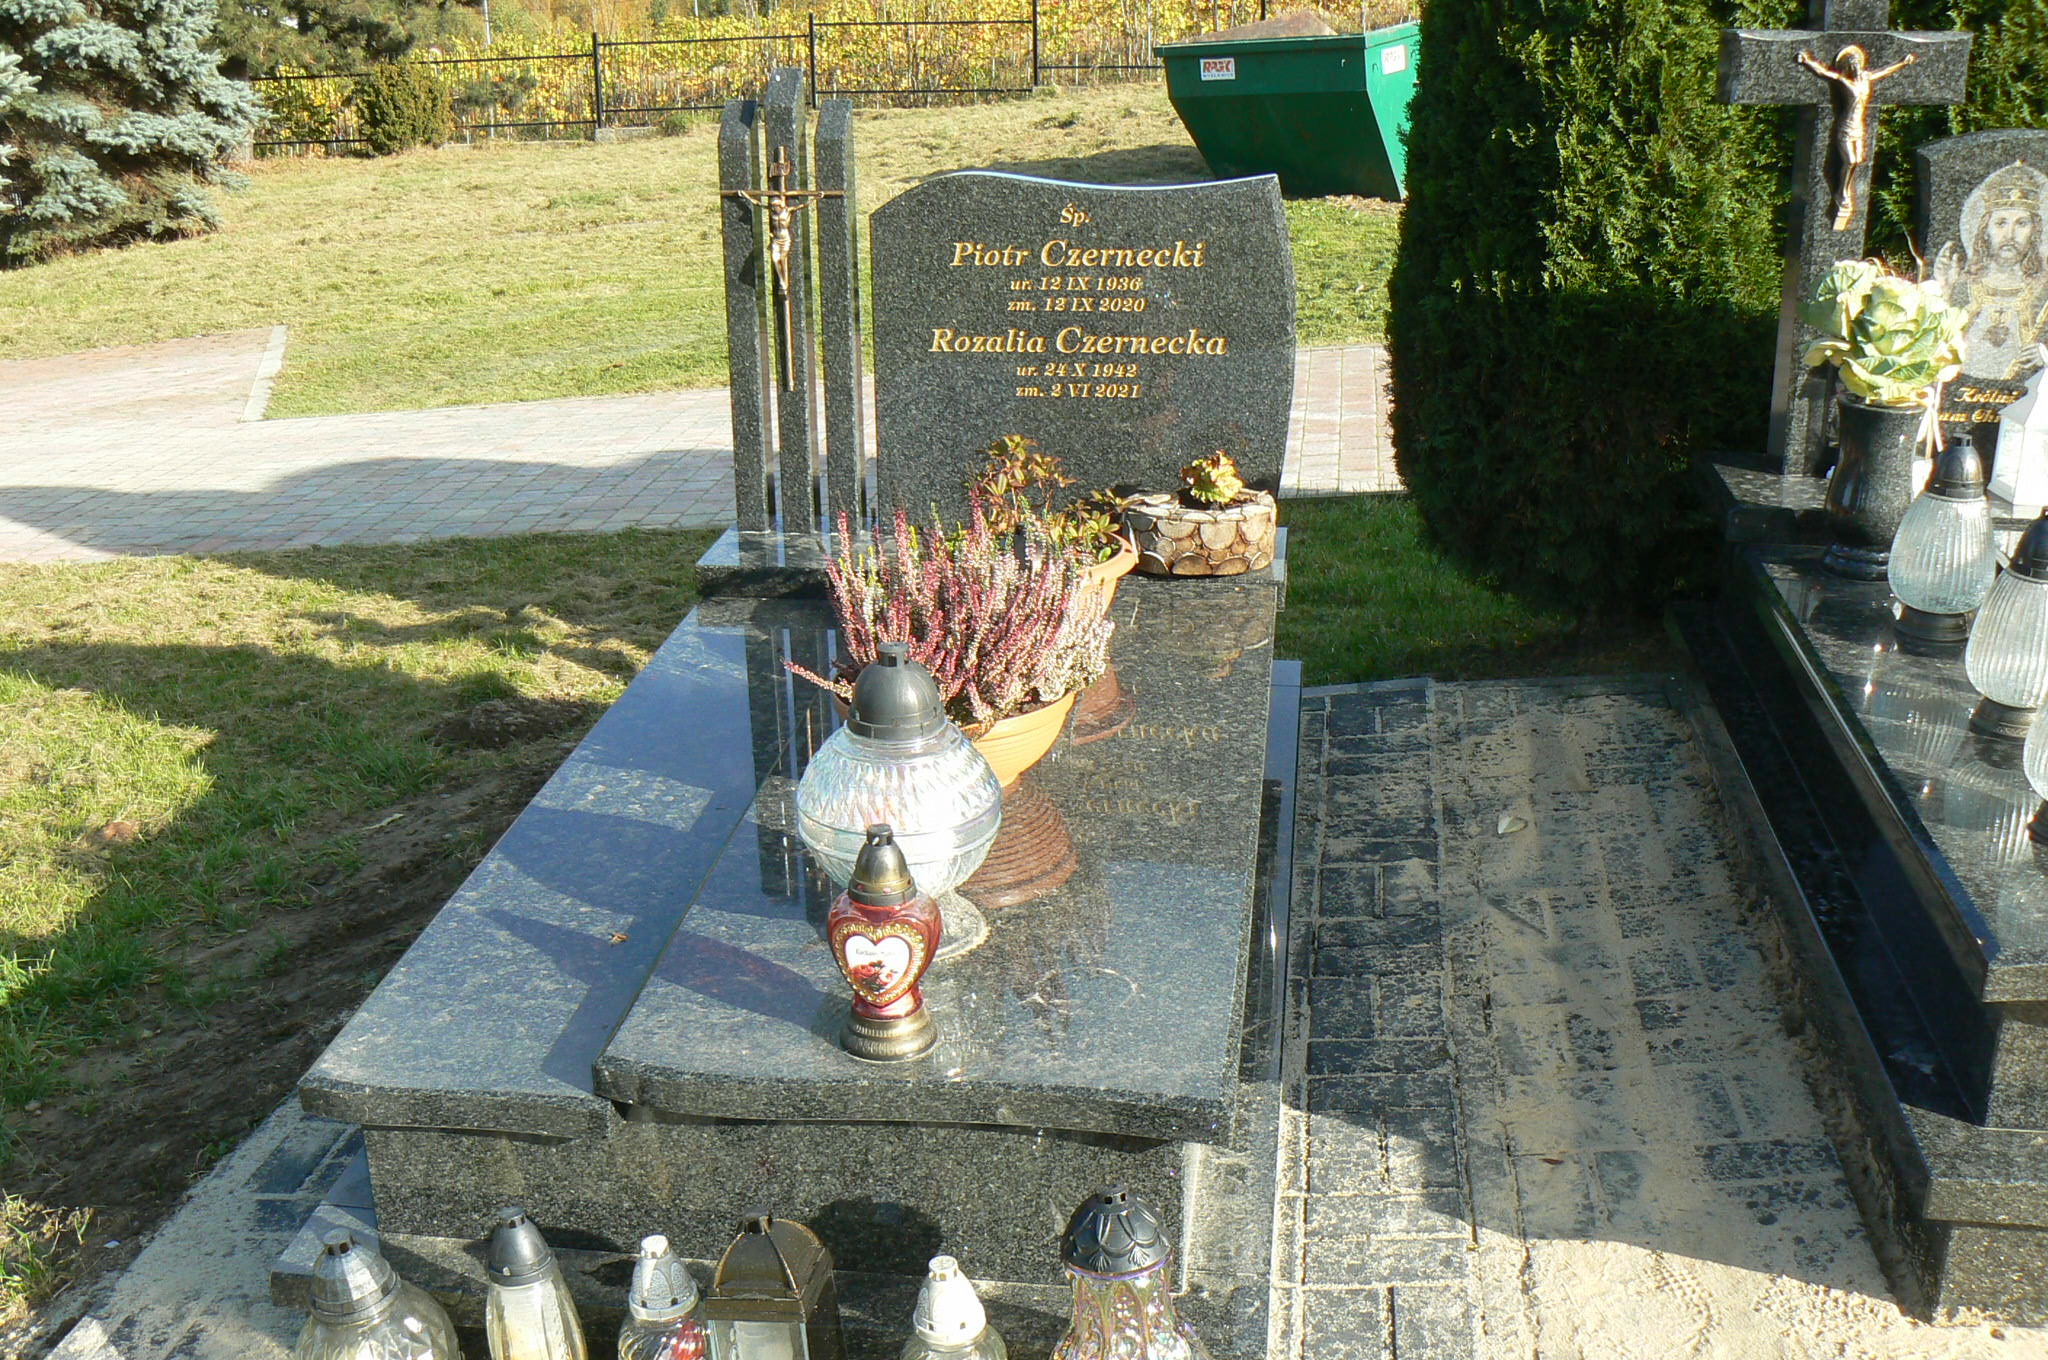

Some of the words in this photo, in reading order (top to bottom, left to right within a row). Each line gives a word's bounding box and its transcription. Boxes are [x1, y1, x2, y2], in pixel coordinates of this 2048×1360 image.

[1060, 203, 1091, 227] Śp.
[950, 241, 1032, 266] Piotr
[1040, 239, 1206, 267] Czernecki
[1010, 279, 1033, 291] ur.
[1039, 276, 1063, 291] 12
[1066, 276, 1091, 291] IX
[1097, 276, 1144, 291] 1936
[1007, 300, 1038, 312] zm.
[1045, 297, 1067, 312] 12
[1071, 297, 1095, 312] IX
[1099, 297, 1147, 313] 2020
[928, 327, 1047, 353] Rozalia
[1055, 326, 1228, 356] Czernecka
[1016, 365, 1040, 377] ur.
[1044, 362, 1068, 377] 24
[1070, 362, 1088, 377] X
[1092, 363, 1139, 378] 1942
[1015, 386, 1046, 397] zm.
[1051, 383, 1064, 397] 2
[1068, 383, 1092, 397] VI
[1094, 383, 1141, 398] 2021
